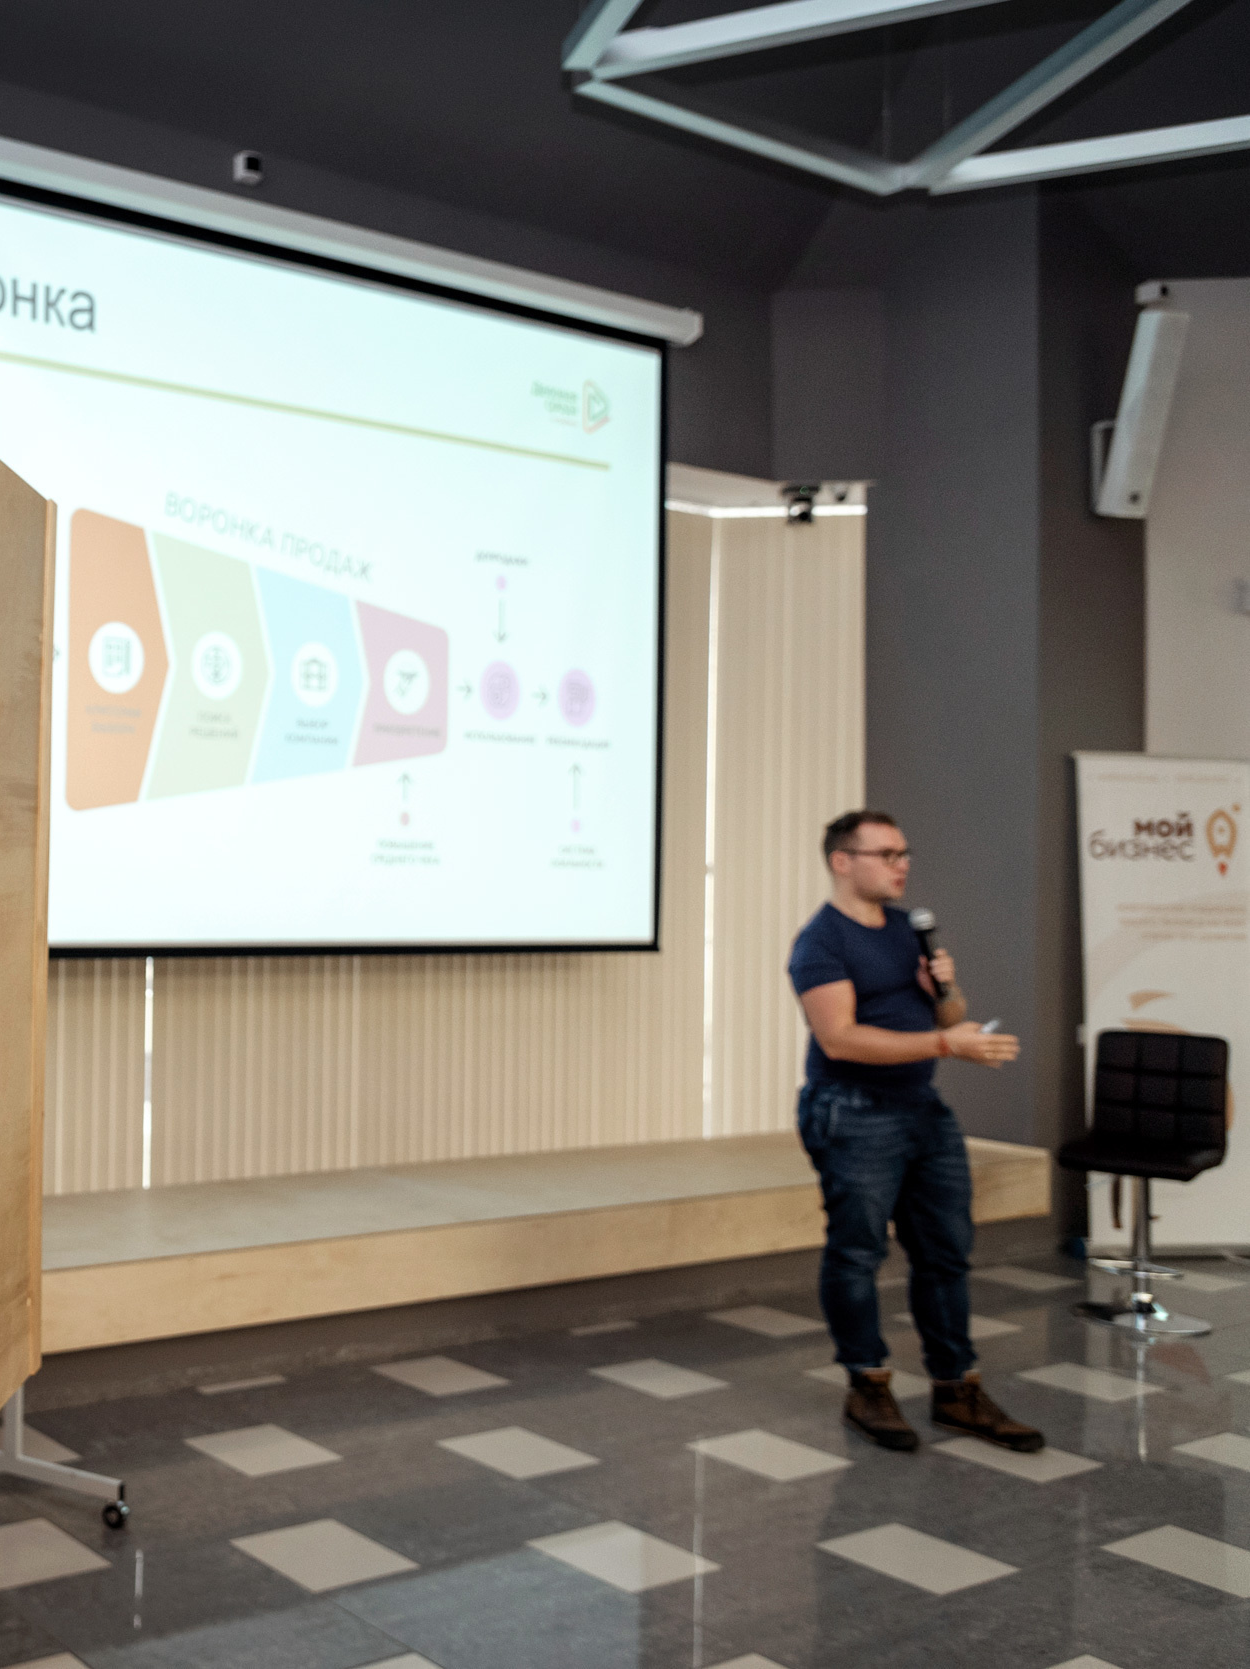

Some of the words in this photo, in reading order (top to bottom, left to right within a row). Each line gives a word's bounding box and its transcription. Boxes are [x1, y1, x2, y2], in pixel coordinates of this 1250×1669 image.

[164, 490, 276, 549] ВОРОНКА
[280, 531, 374, 582] ПРОДАЖ
[1088, 828, 1196, 862] бизнес
